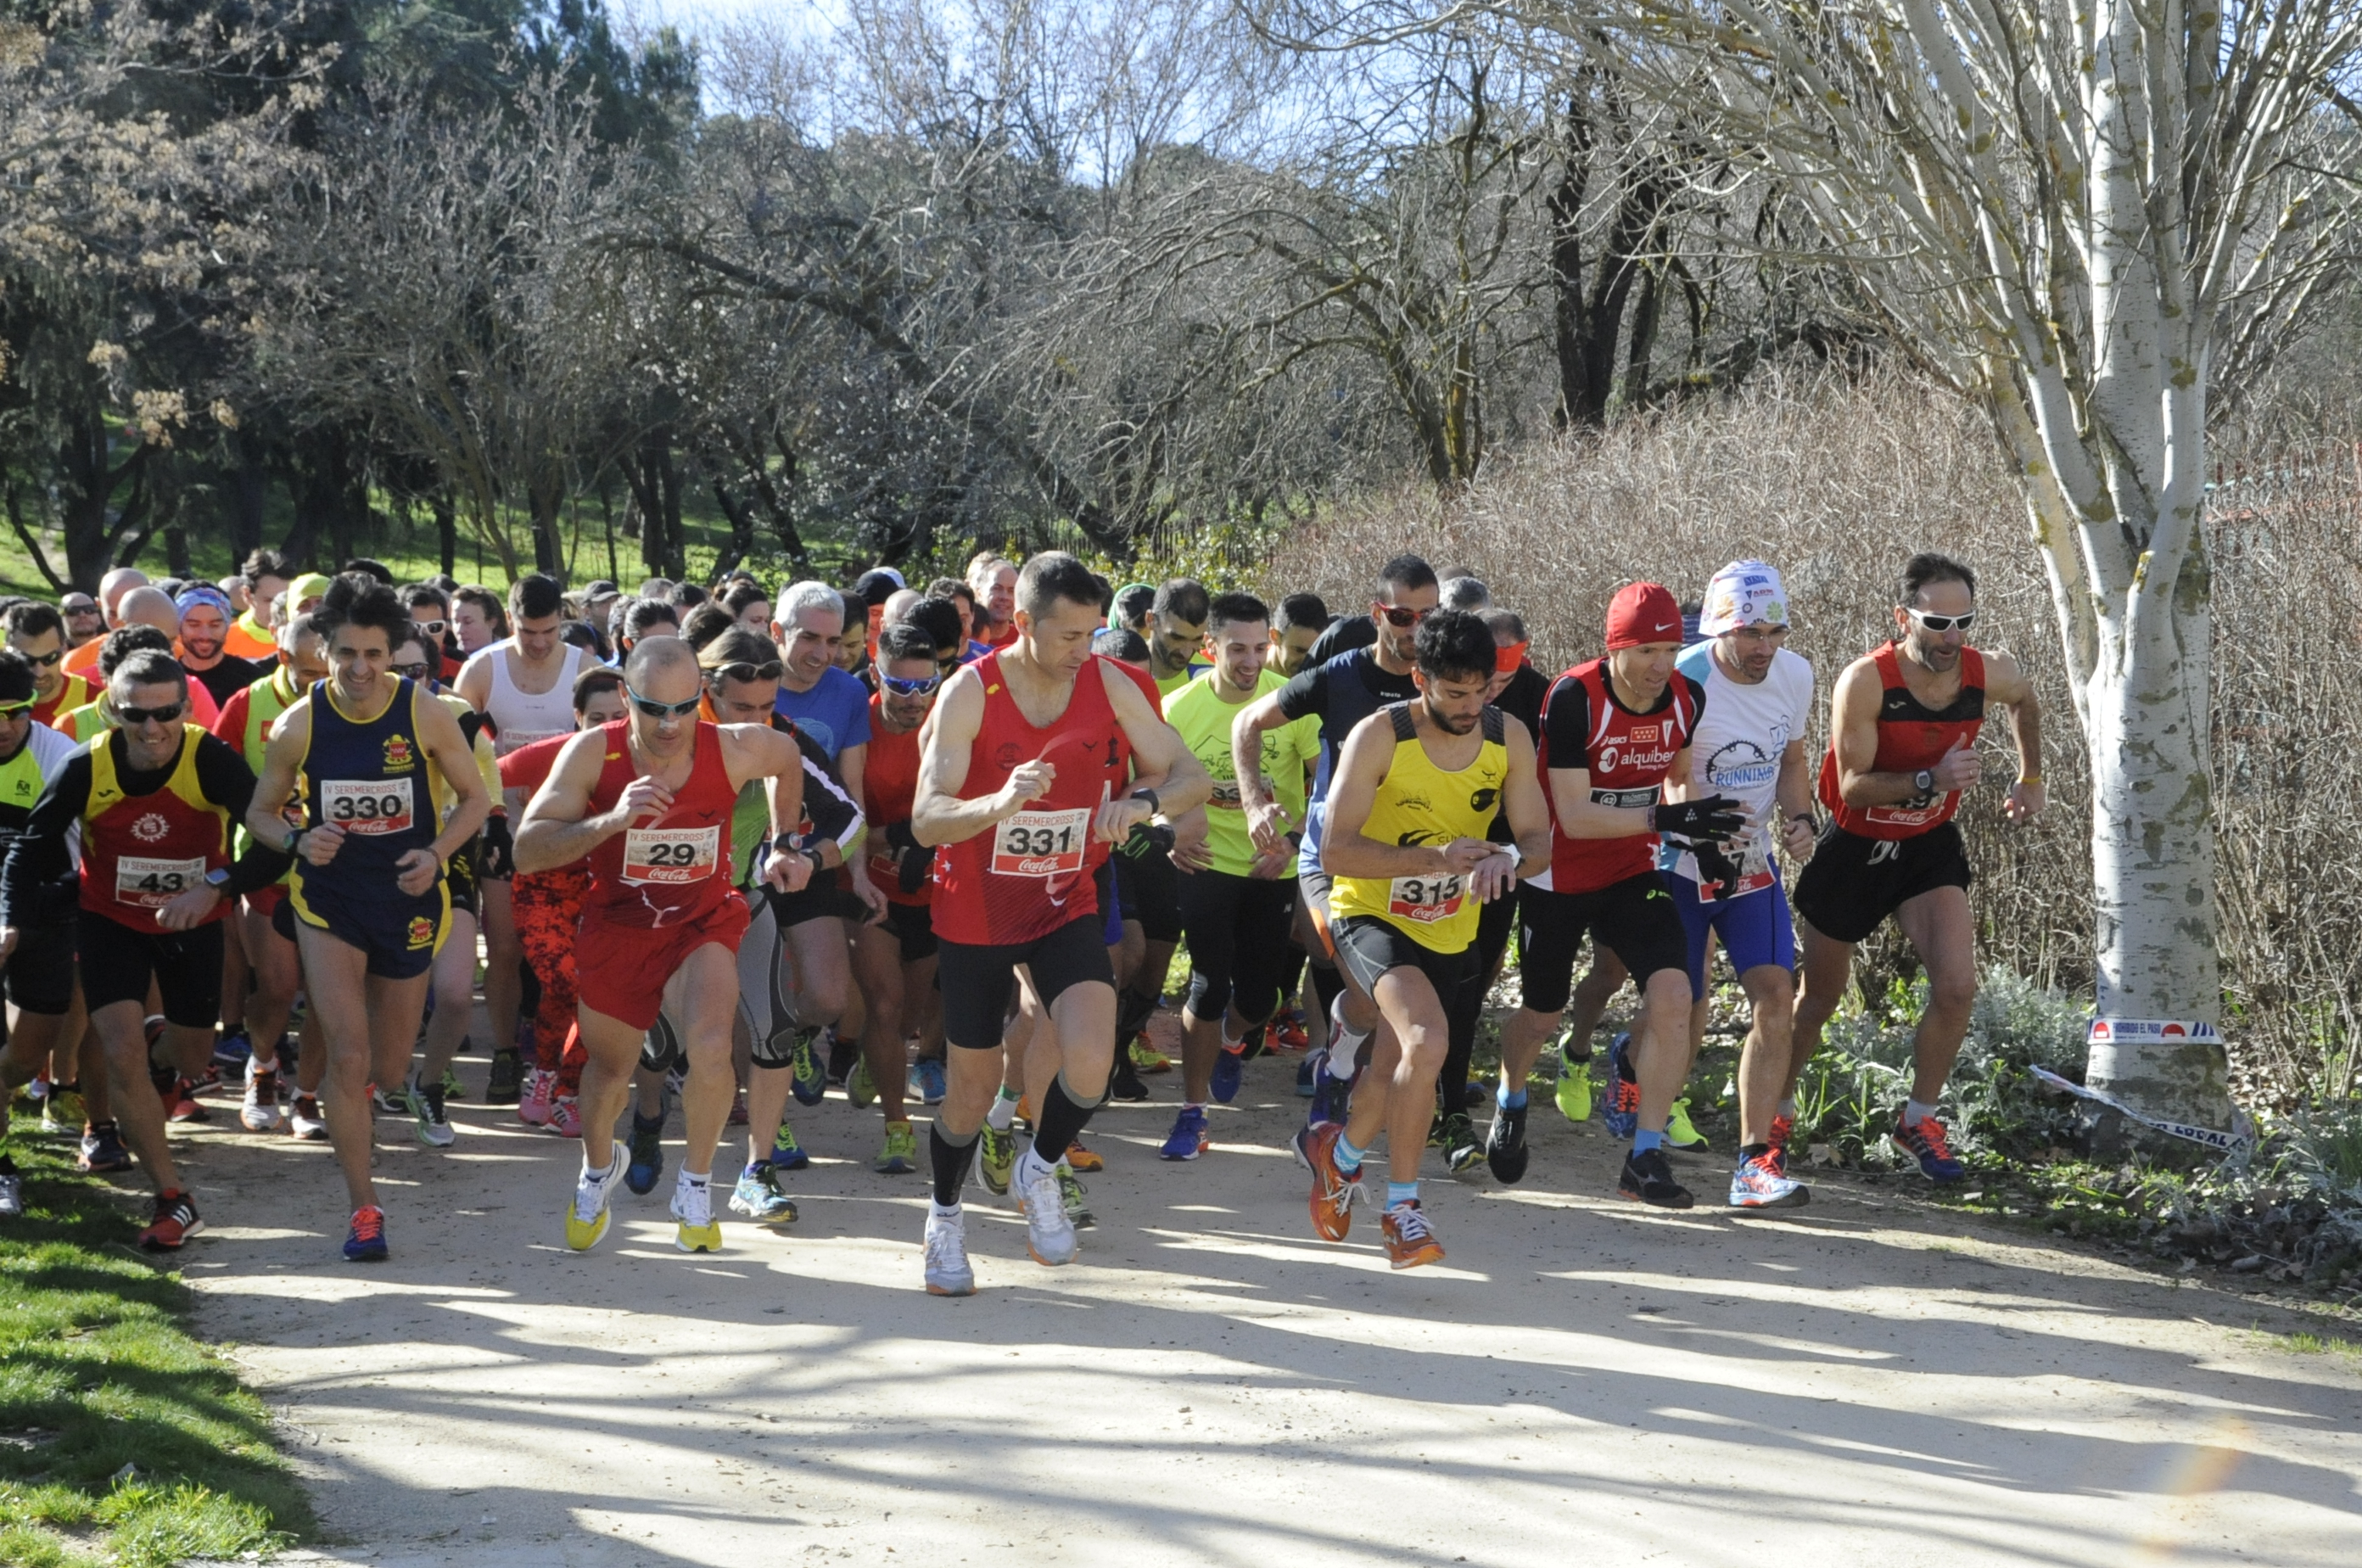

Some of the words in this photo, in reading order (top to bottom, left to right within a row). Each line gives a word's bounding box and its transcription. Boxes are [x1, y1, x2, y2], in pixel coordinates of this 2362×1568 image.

[1620, 746, 1675, 770] alquiber
[1716, 765, 1774, 787] RUNNING
[334, 784, 397, 795] SEREMERCROSS
[333, 795, 402, 820] 330
[1012, 815, 1076, 827] SEREMERCROSS
[641, 832, 704, 843] SEREMERCROSS
[1006, 826, 1072, 856] 331
[648, 843, 696, 866] 29
[138, 872, 183, 893] 43
[1401, 875, 1459, 905] 315
[2113, 1022, 2138, 1033] PROHIBIDO
[2140, 1022, 2147, 1033] EL
[2147, 1023, 2161, 1034] PASO
